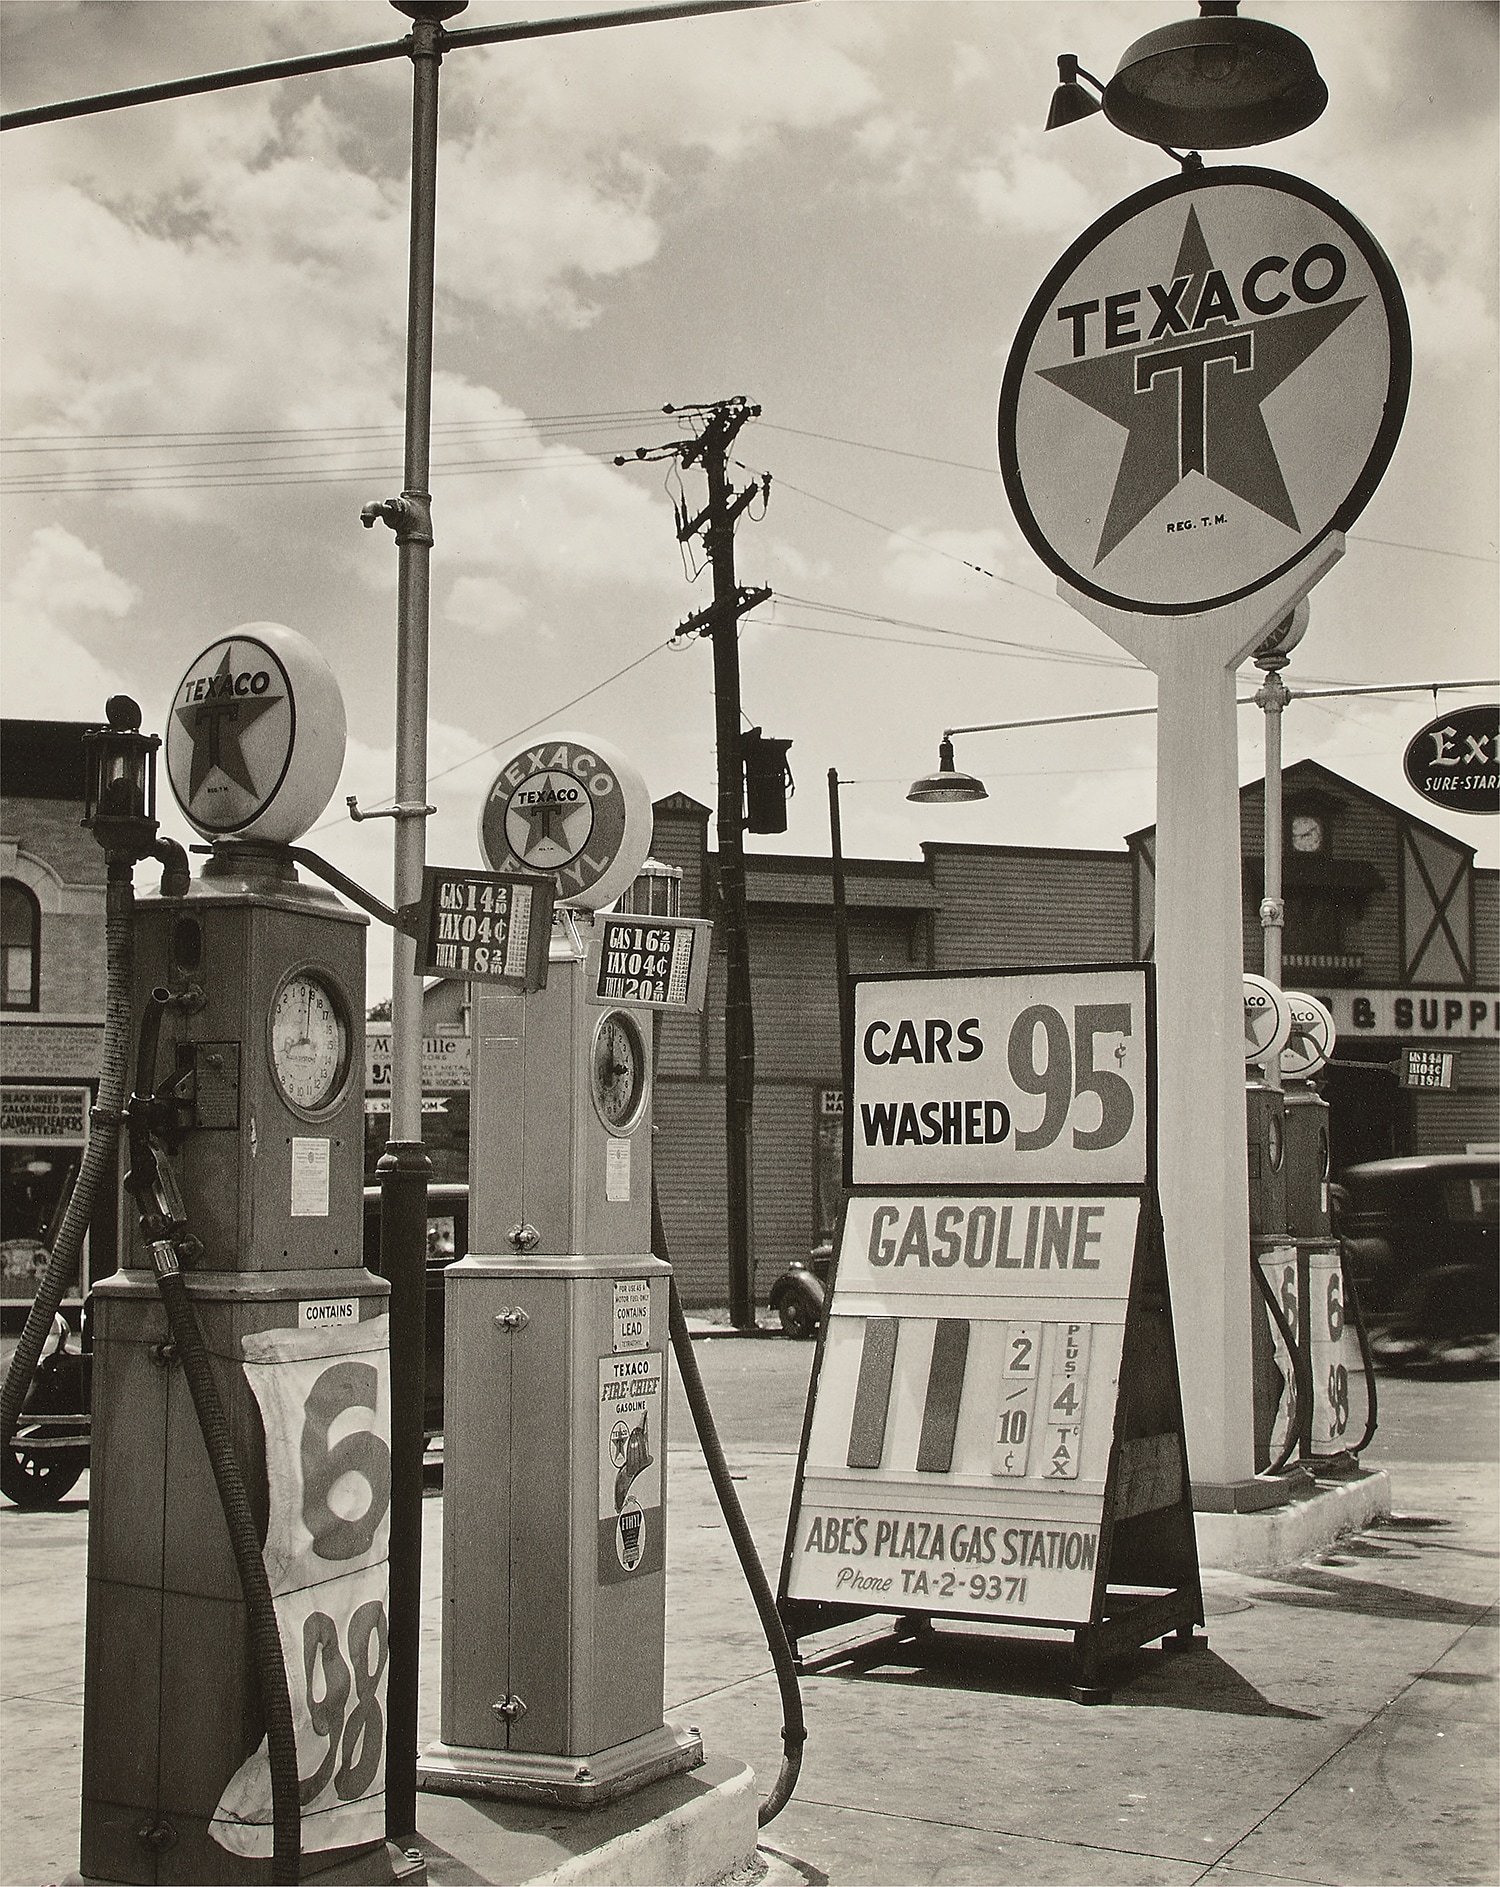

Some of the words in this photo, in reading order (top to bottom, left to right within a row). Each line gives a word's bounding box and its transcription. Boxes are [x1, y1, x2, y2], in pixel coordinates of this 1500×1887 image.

[1057, 243, 1347, 358] TEXACO
[1133, 329, 1255, 482] T
[1166, 519, 1197, 533] REG.
[185, 671, 271, 702] TEXACO
[490, 746, 614, 802] TEXACO
[518, 788, 578, 804] TEXACO
[440, 883, 464, 909] GAS
[466, 885, 494, 913] 14
[439, 913, 462, 940] TAX
[609, 926, 632, 949] GAS
[633, 928, 660, 951] 16
[461, 946, 490, 973] 18
[607, 952, 628, 974] TAX
[625, 978, 653, 1000] 20
[1353, 997, 1376, 1028] &
[863, 1018, 984, 1065] CARS
[2, 1105, 59, 1114] GALVANIZED
[860, 1100, 1011, 1146] WASHED
[867, 1205, 1106, 1270] GASOLINE
[306, 1304, 353, 1320] CONTAINS
[617, 1306, 647, 1319] CONTAINS
[1327, 1273, 1345, 1343] 6
[621, 1321, 642, 1336] LEAD
[1064, 1325, 1081, 1373] PLUS
[613, 1361, 649, 1377] TEXACO
[601, 1377, 660, 1401] FIRE-CHIEF
[615, 1401, 646, 1414] GASOLINE
[301, 1361, 391, 1561] 6
[804, 1515, 869, 1556] ABE'S
[874, 1520, 945, 1561] PLAZA
[950, 1524, 998, 1565] GAS
[1001, 1528, 1098, 1571] STATION
[836, 1567, 894, 1592] Phone
[901, 1568, 1029, 1603] TA-2-9371
